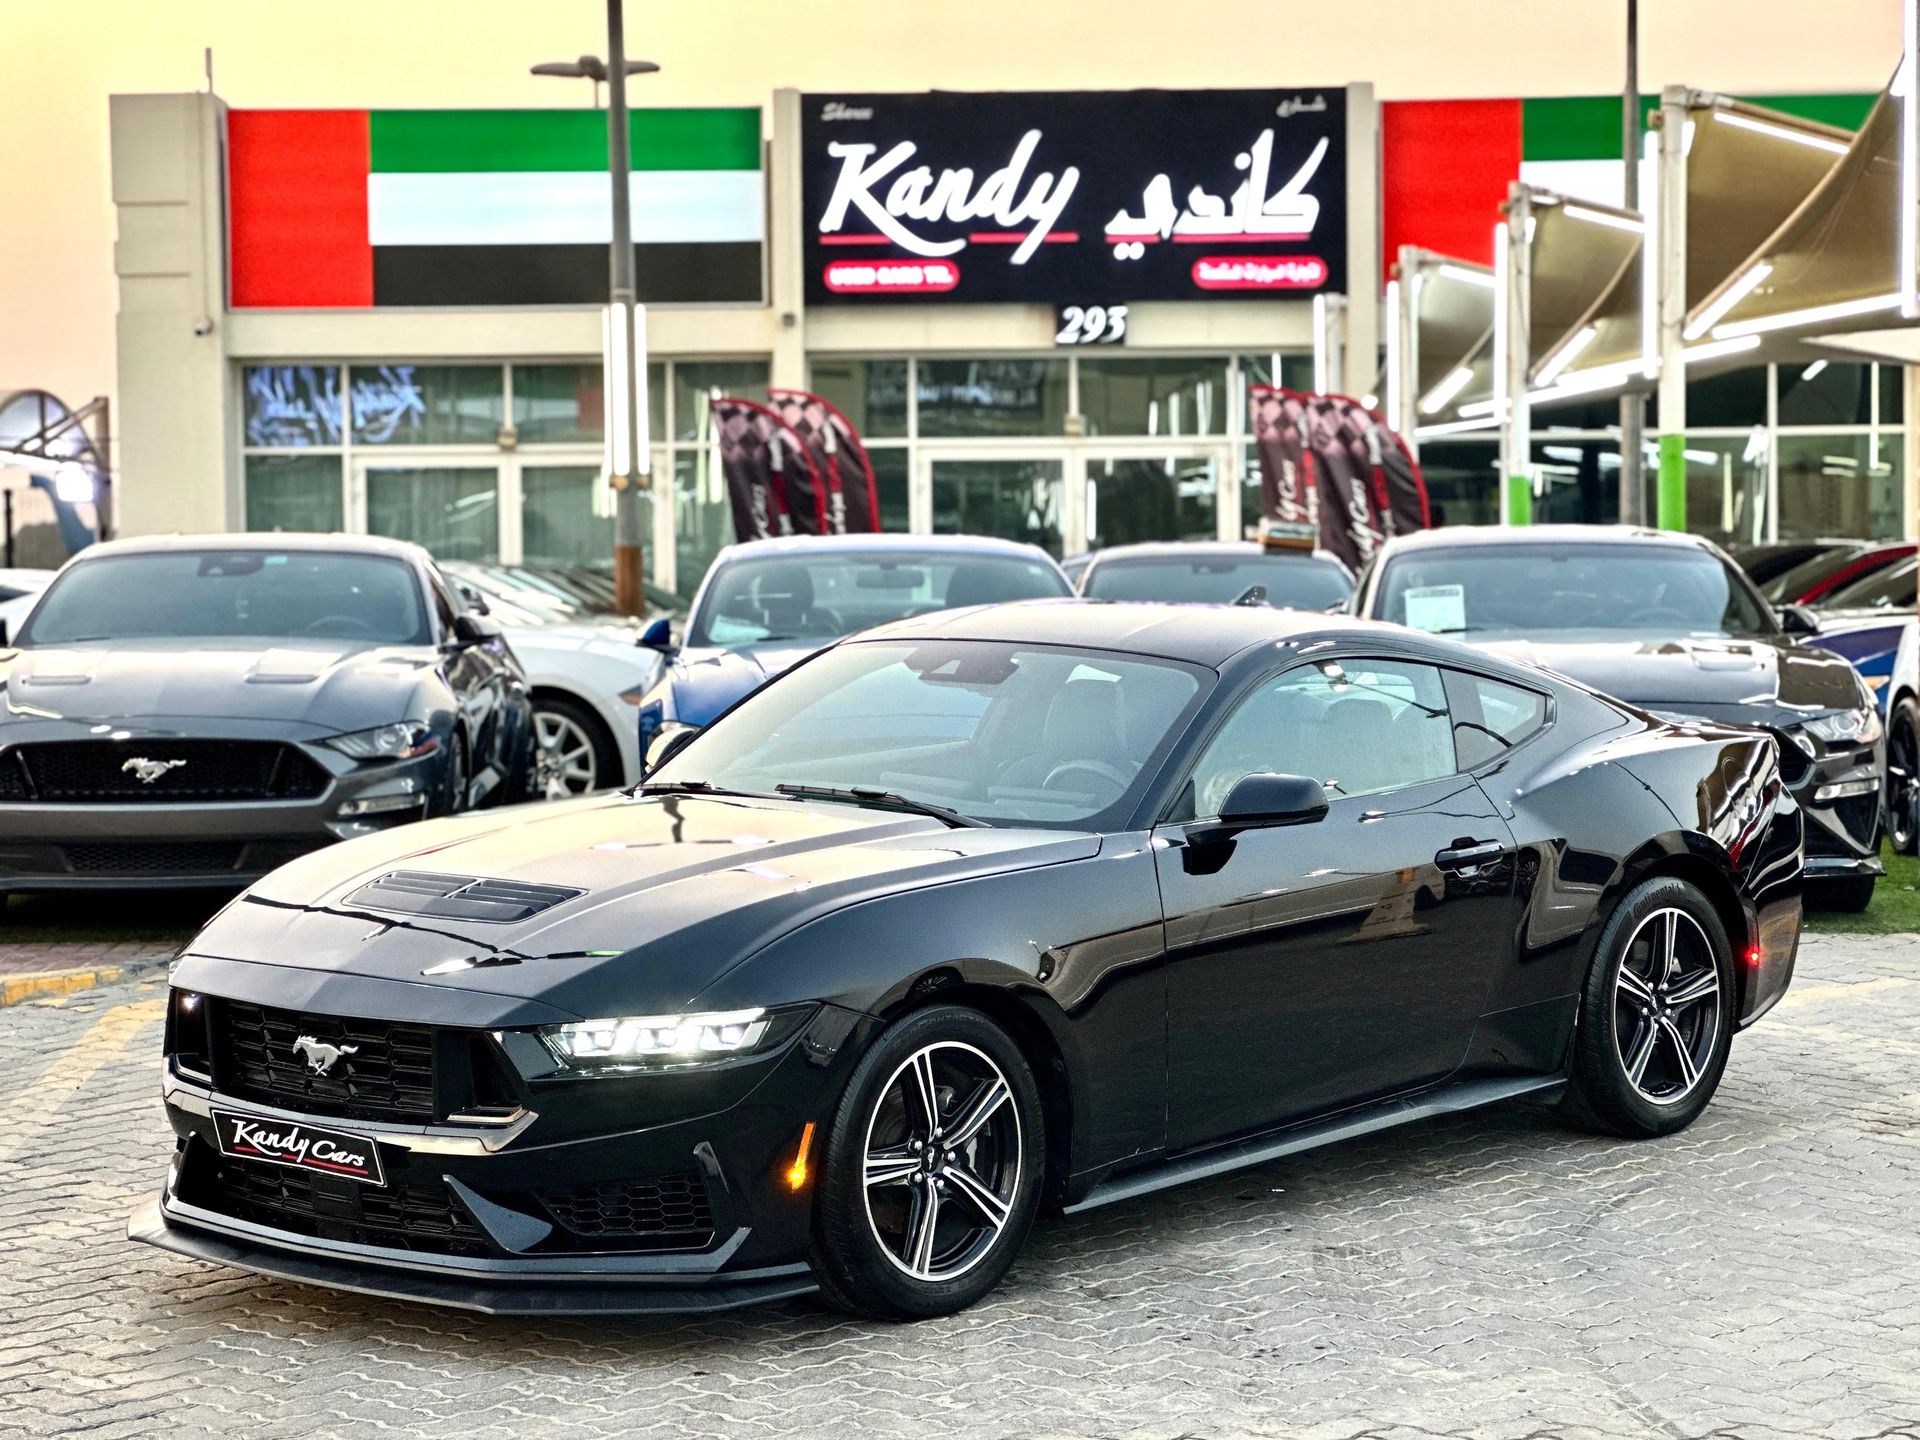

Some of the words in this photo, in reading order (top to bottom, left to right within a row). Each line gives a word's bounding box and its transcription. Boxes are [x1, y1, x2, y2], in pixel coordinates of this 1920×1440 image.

[818, 128, 1081, 265] Kandy
[1104, 128, 1330, 261] كاندي
[231, 1118, 310, 1163] Kandy
[311, 1140, 366, 1167] Cars
